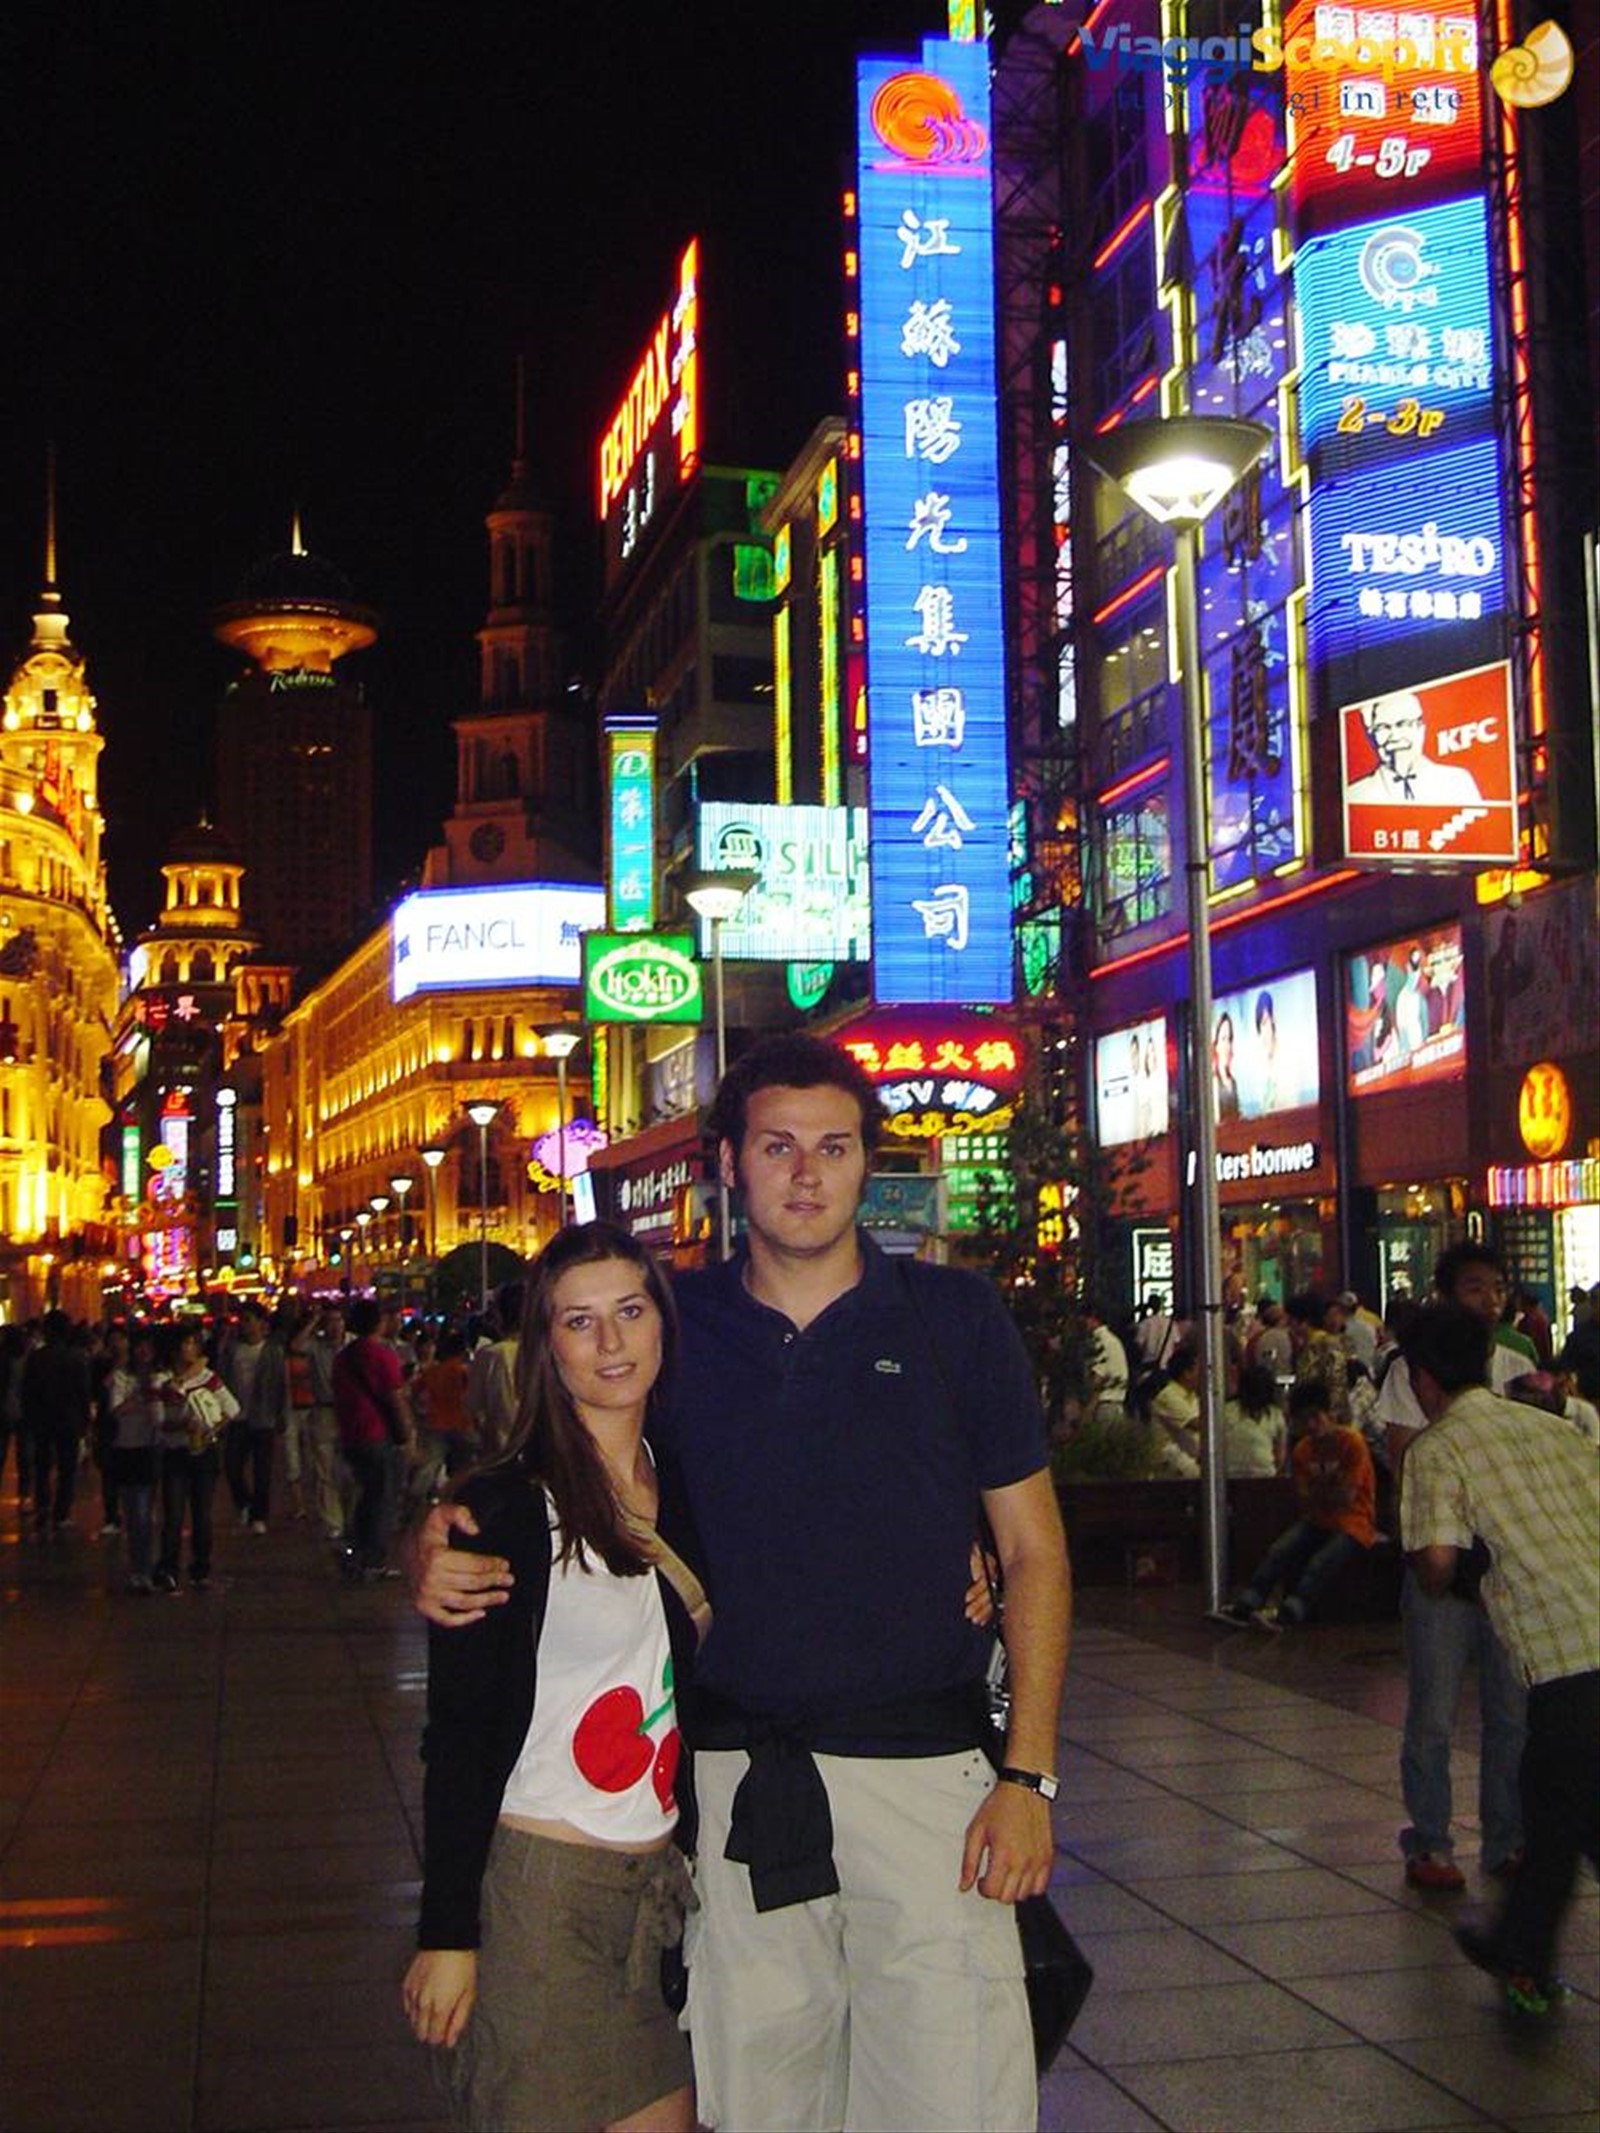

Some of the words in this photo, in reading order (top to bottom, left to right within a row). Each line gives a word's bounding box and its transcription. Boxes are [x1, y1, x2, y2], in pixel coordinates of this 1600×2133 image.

[601, 312, 670, 521] PENTAX
[1437, 717, 1500, 757] KFC
[426, 919, 525, 953] FANCL
